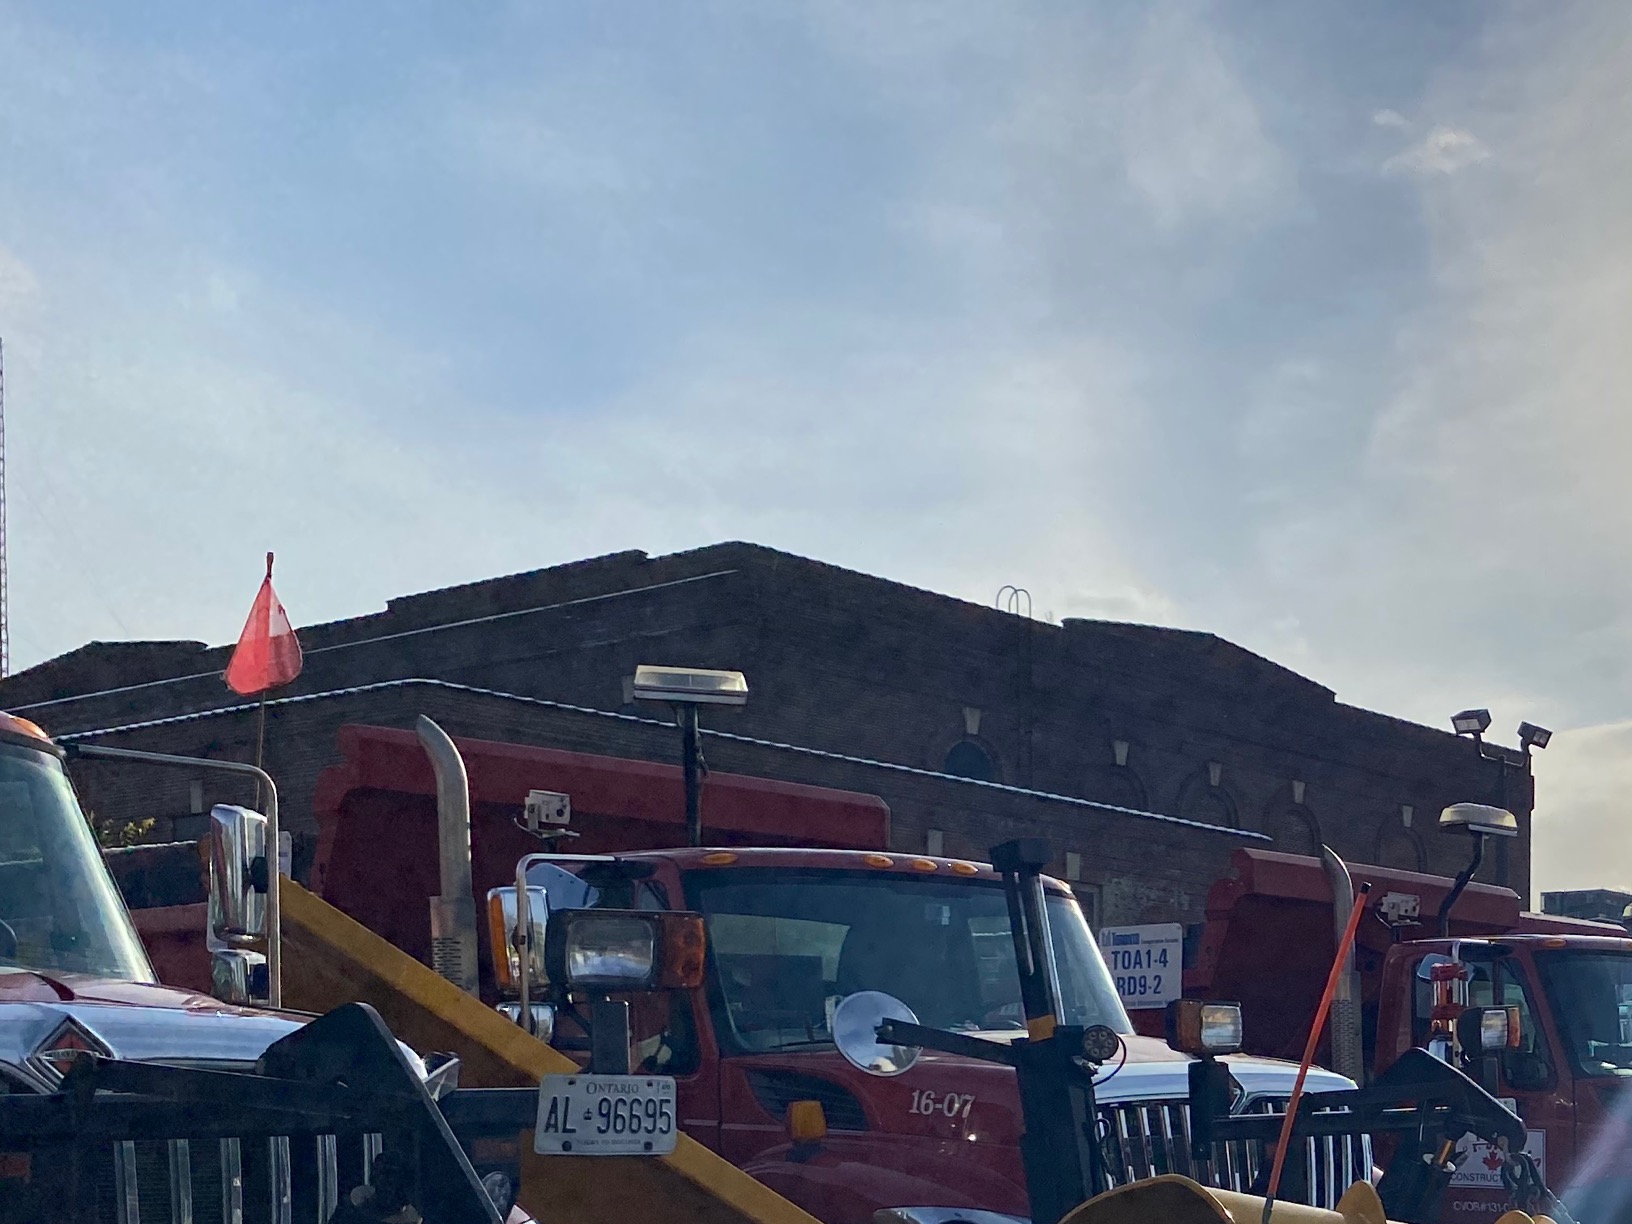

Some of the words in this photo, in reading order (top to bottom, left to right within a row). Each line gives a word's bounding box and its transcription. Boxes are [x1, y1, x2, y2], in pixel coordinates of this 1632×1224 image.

[1111, 948, 1169, 970] TOA1-4
[1116, 975, 1162, 996] RD9-2
[586, 1082, 640, 1096] ONTARIO
[909, 1090, 976, 1118] 16-07
[544, 1096, 577, 1134] AL
[597, 1097, 672, 1135] 96695
[1451, 1171, 1502, 1183] CONSTRUCT
